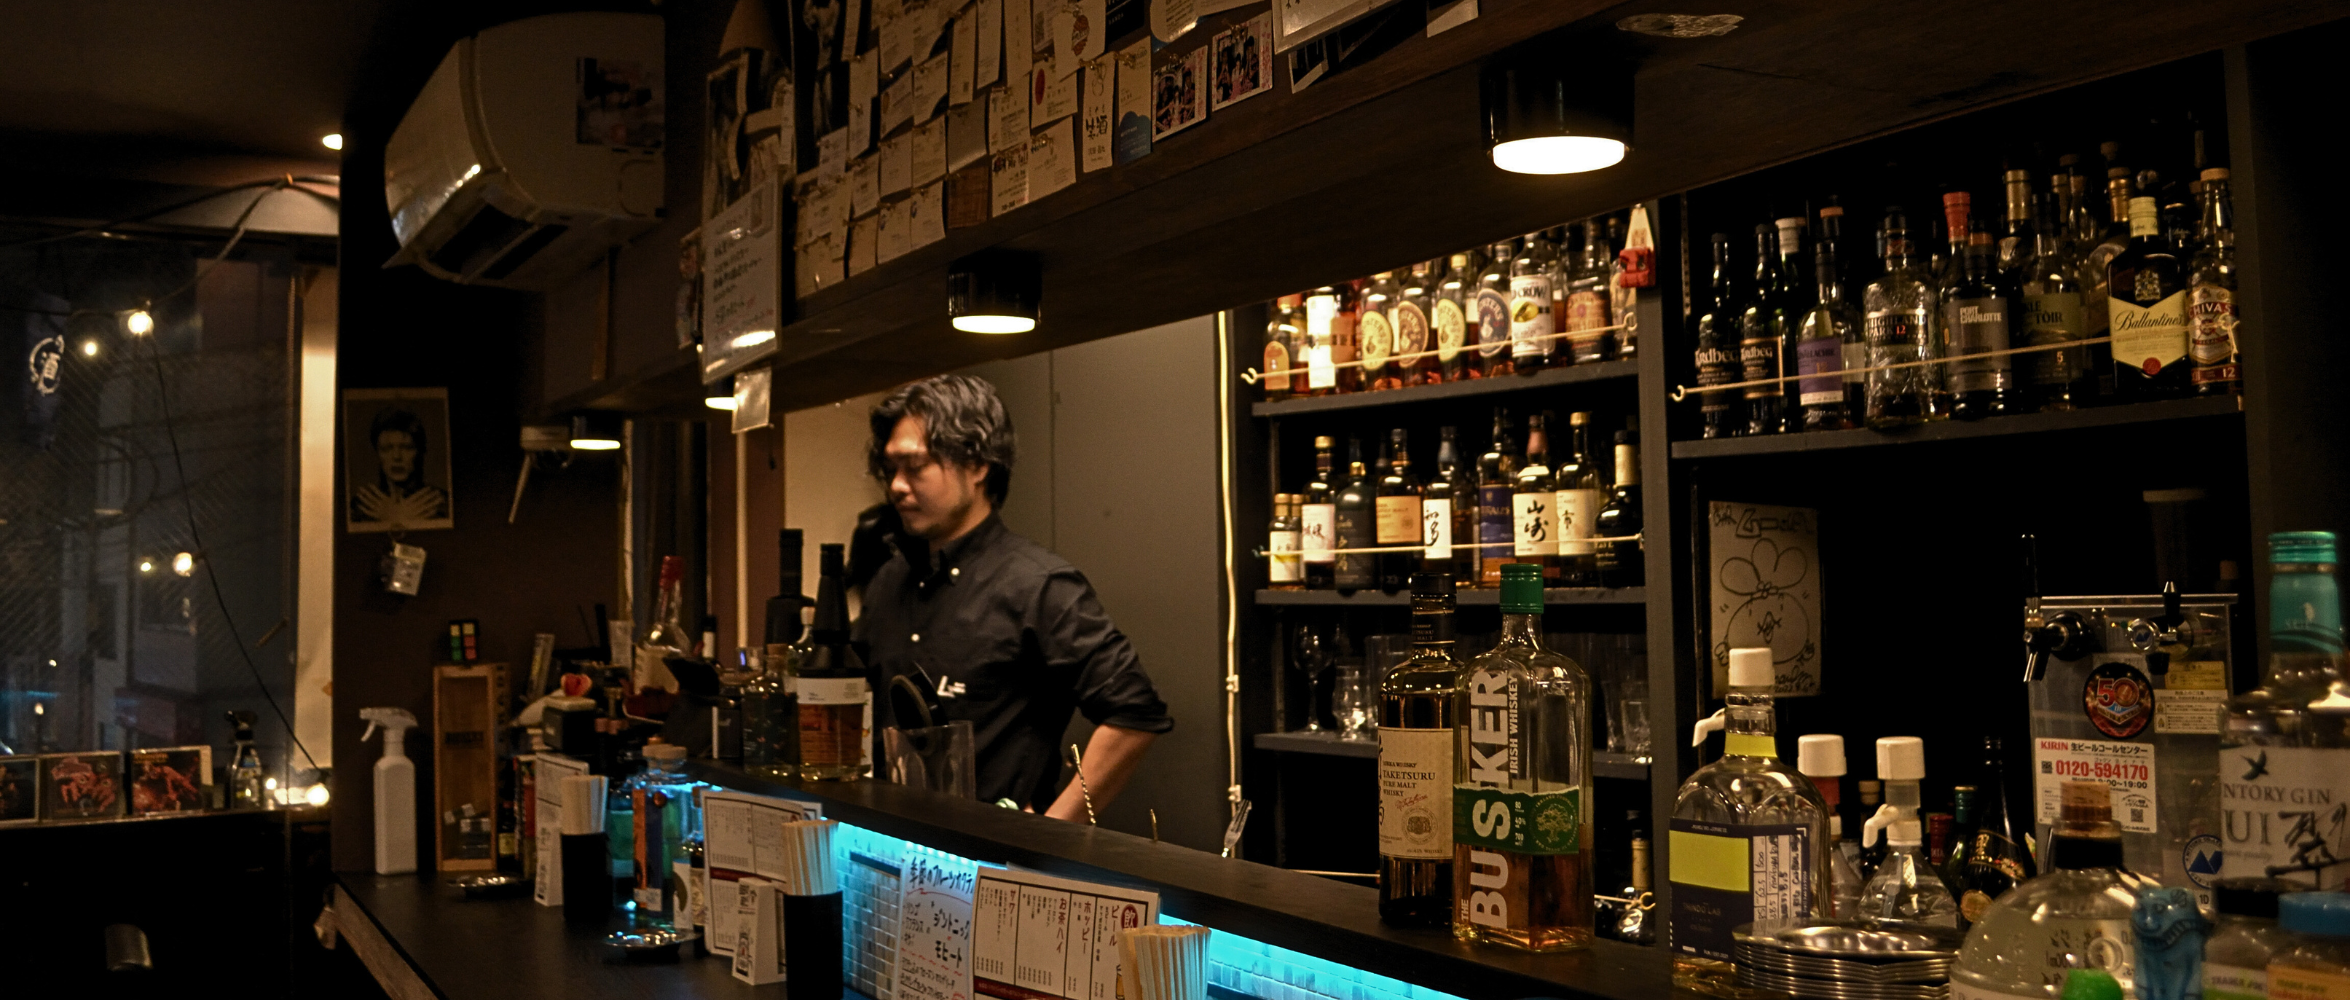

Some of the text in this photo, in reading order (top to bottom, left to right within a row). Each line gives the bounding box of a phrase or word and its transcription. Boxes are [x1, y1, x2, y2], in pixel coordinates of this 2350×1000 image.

[1960, 312, 2002, 324] CHARLOTTE
[2189, 302, 2232, 318] CHIVAS
[1895, 324, 1906, 335] 12
[2114, 310, 2184, 331] Ballantine's
[2222, 367, 2236, 378] 12
[1508, 676, 1518, 774] IRISH WHISKEY
[2041, 741, 2148, 754] KIRIN 生ビールコールセンター
[1383, 770, 1436, 780] TAKETSURU
[2056, 760, 2148, 780] 0120-594170
[1383, 789, 1404, 797] WHISKY
[1397, 781, 1417, 789] MALT
[1461, 669, 1511, 929] THE BUSKER
[2290, 787, 2331, 804] GIN
[1008, 890, 1016, 928] サワー
[1056, 898, 1067, 953] お茶ハイ
[1082, 901, 1092, 954] ホッピー
[1109, 905, 1120, 946] ビール
[935, 940, 962, 969] モヒート
